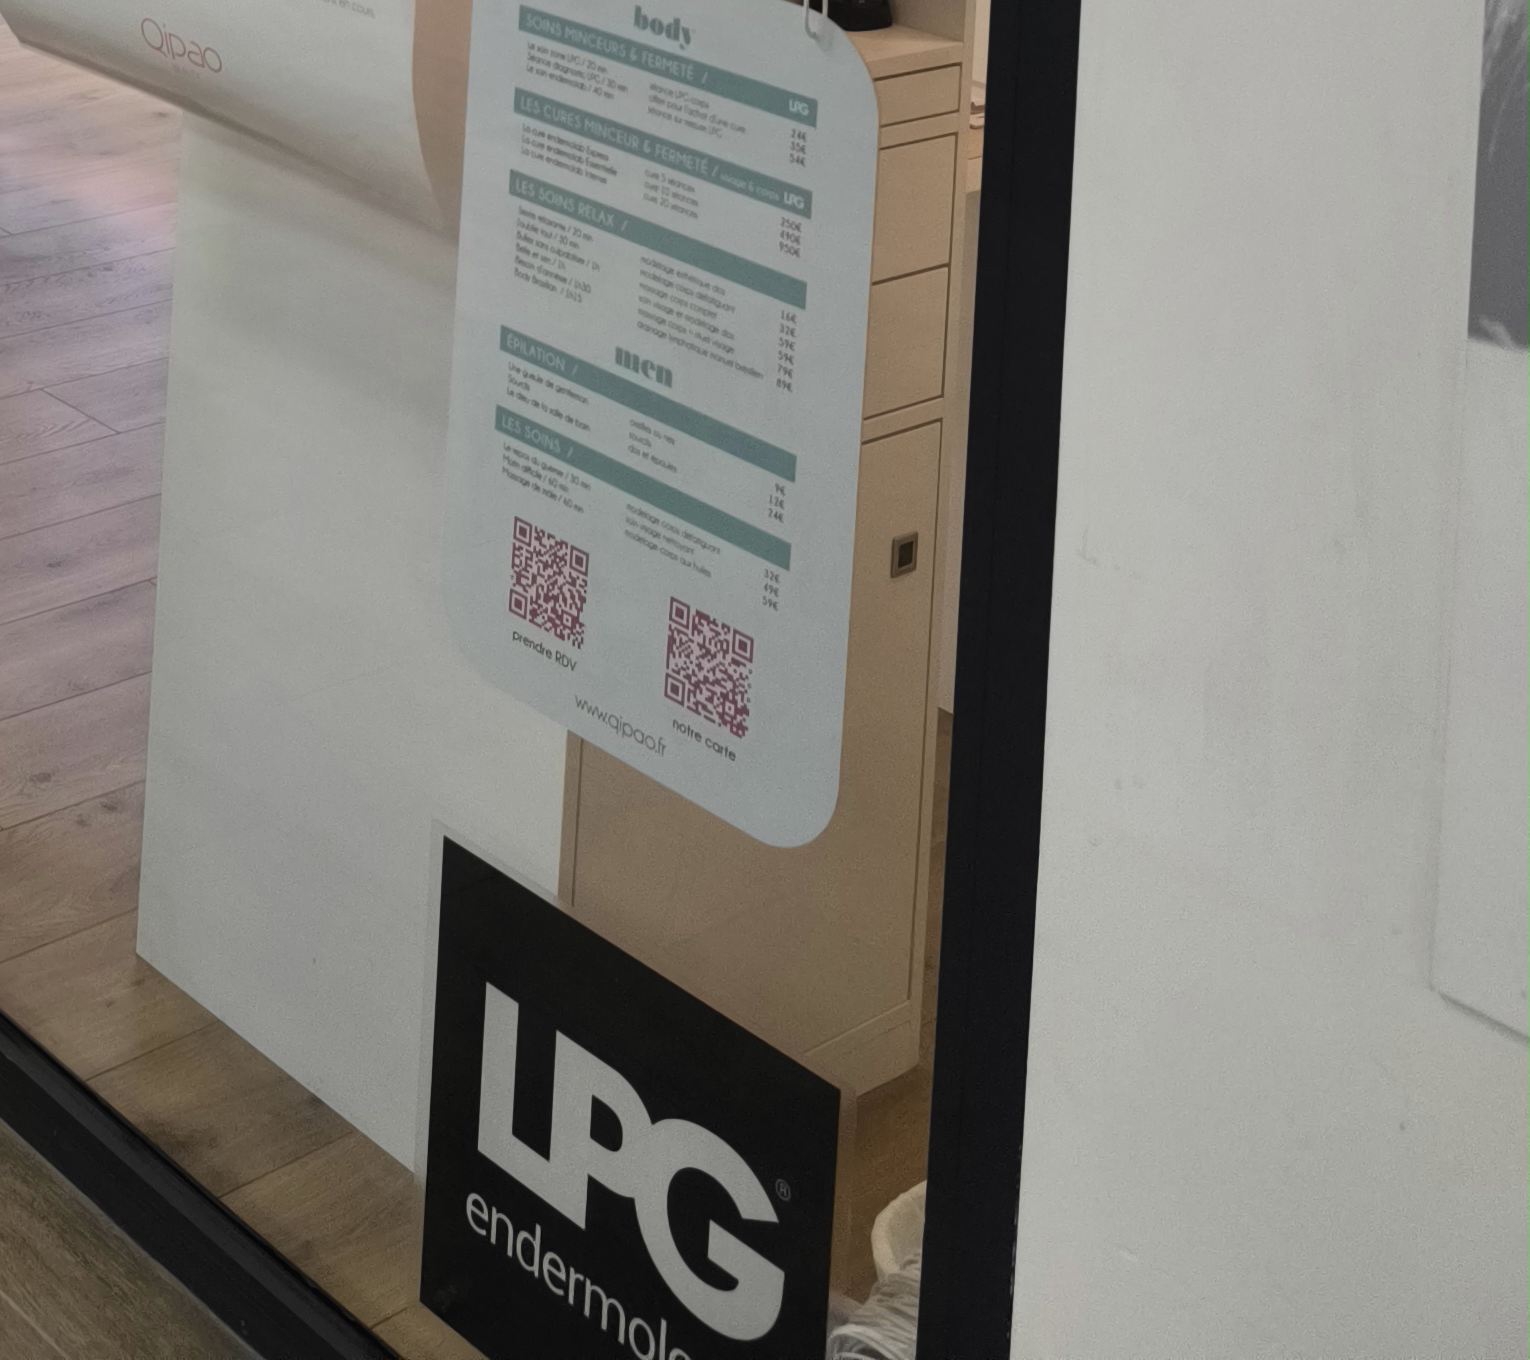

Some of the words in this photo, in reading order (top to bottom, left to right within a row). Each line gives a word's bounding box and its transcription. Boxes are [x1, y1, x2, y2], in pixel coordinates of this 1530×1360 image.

[140, 17, 223, 74] Qipao
[526, 13, 563, 37] SOINS
[565, 26, 627, 61] MINCEURS
[641, 48, 694, 80] FERMETÉ
[634, 4, 692, 51] body
[520, 95, 541, 115] LES
[543, 103, 582, 130] CURES
[584, 117, 640, 149] MINCEUR
[654, 146, 710, 175] FERMETÉ
[515, 178, 536, 198] LES
[538, 187, 576, 212] SOINS
[577, 200, 616, 228] RELAX
[506, 332, 566, 371] ÉPILATION
[615, 346, 674, 389] men
[501, 413, 521, 436] LES
[524, 425, 561, 454] SOINS
[512, 630, 553, 664] prendre
[555, 648, 578, 674] RDV
[575, 693, 668, 757] www.qipao.fr
[672, 717, 703, 743] notre
[704, 735, 738, 763] carte
[476, 981, 785, 1342] LPG
